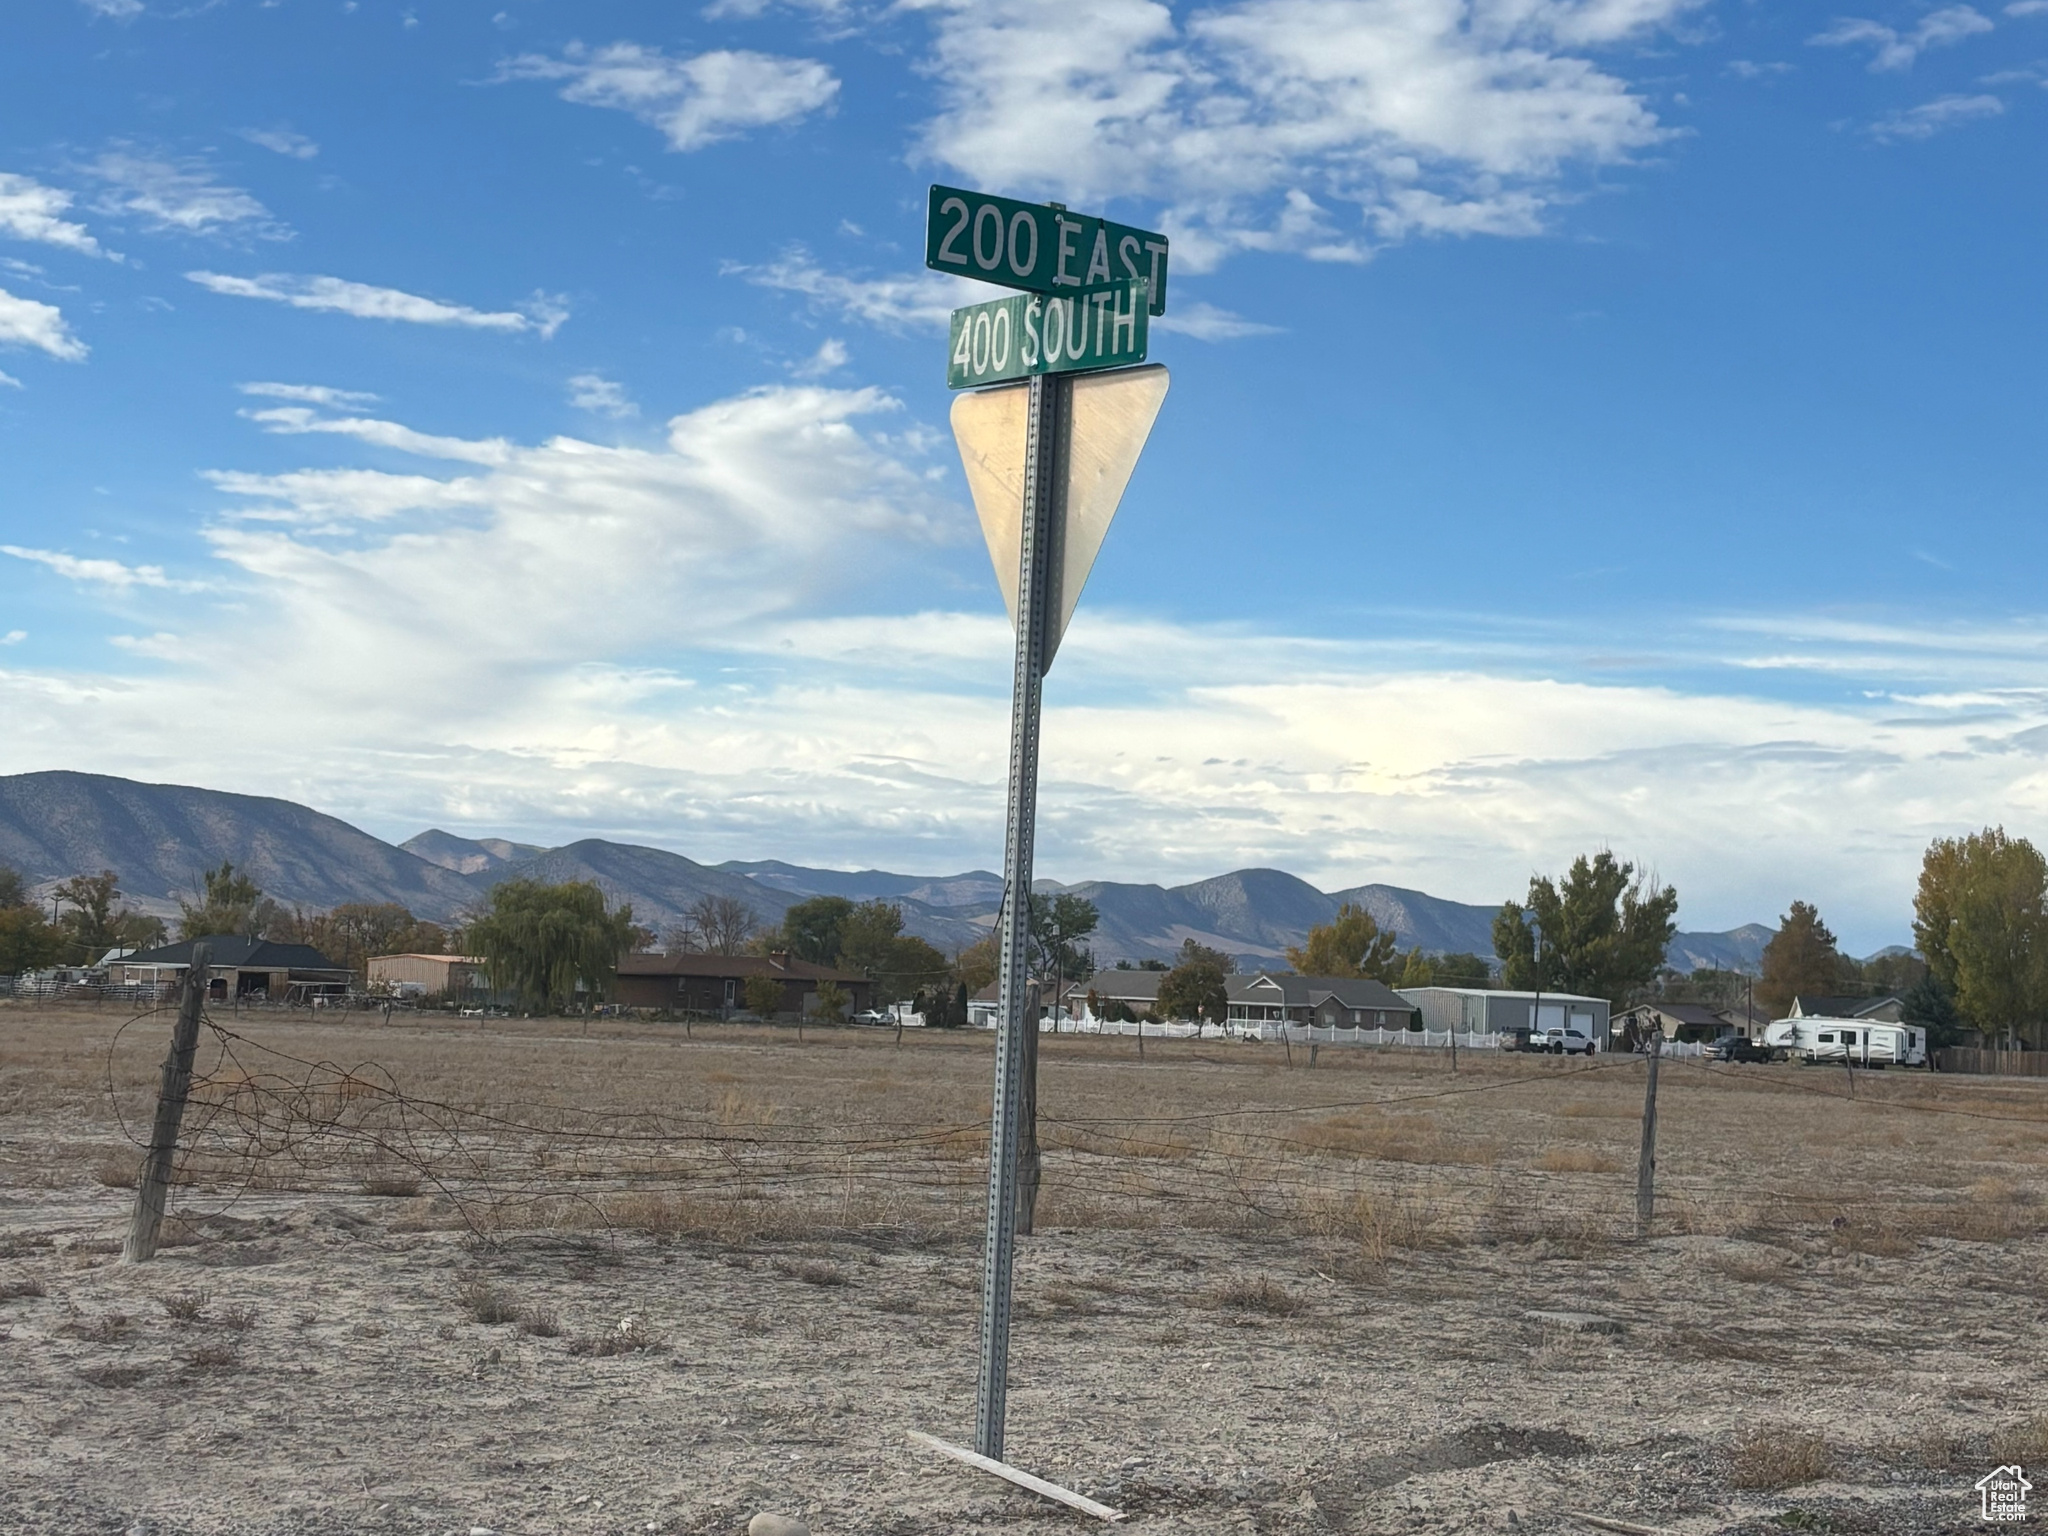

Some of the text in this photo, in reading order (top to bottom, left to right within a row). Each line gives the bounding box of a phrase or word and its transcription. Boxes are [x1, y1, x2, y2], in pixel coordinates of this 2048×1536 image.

[938, 197, 1167, 305] 200 EAST
[953, 287, 1137, 377] 400 SOUTH
